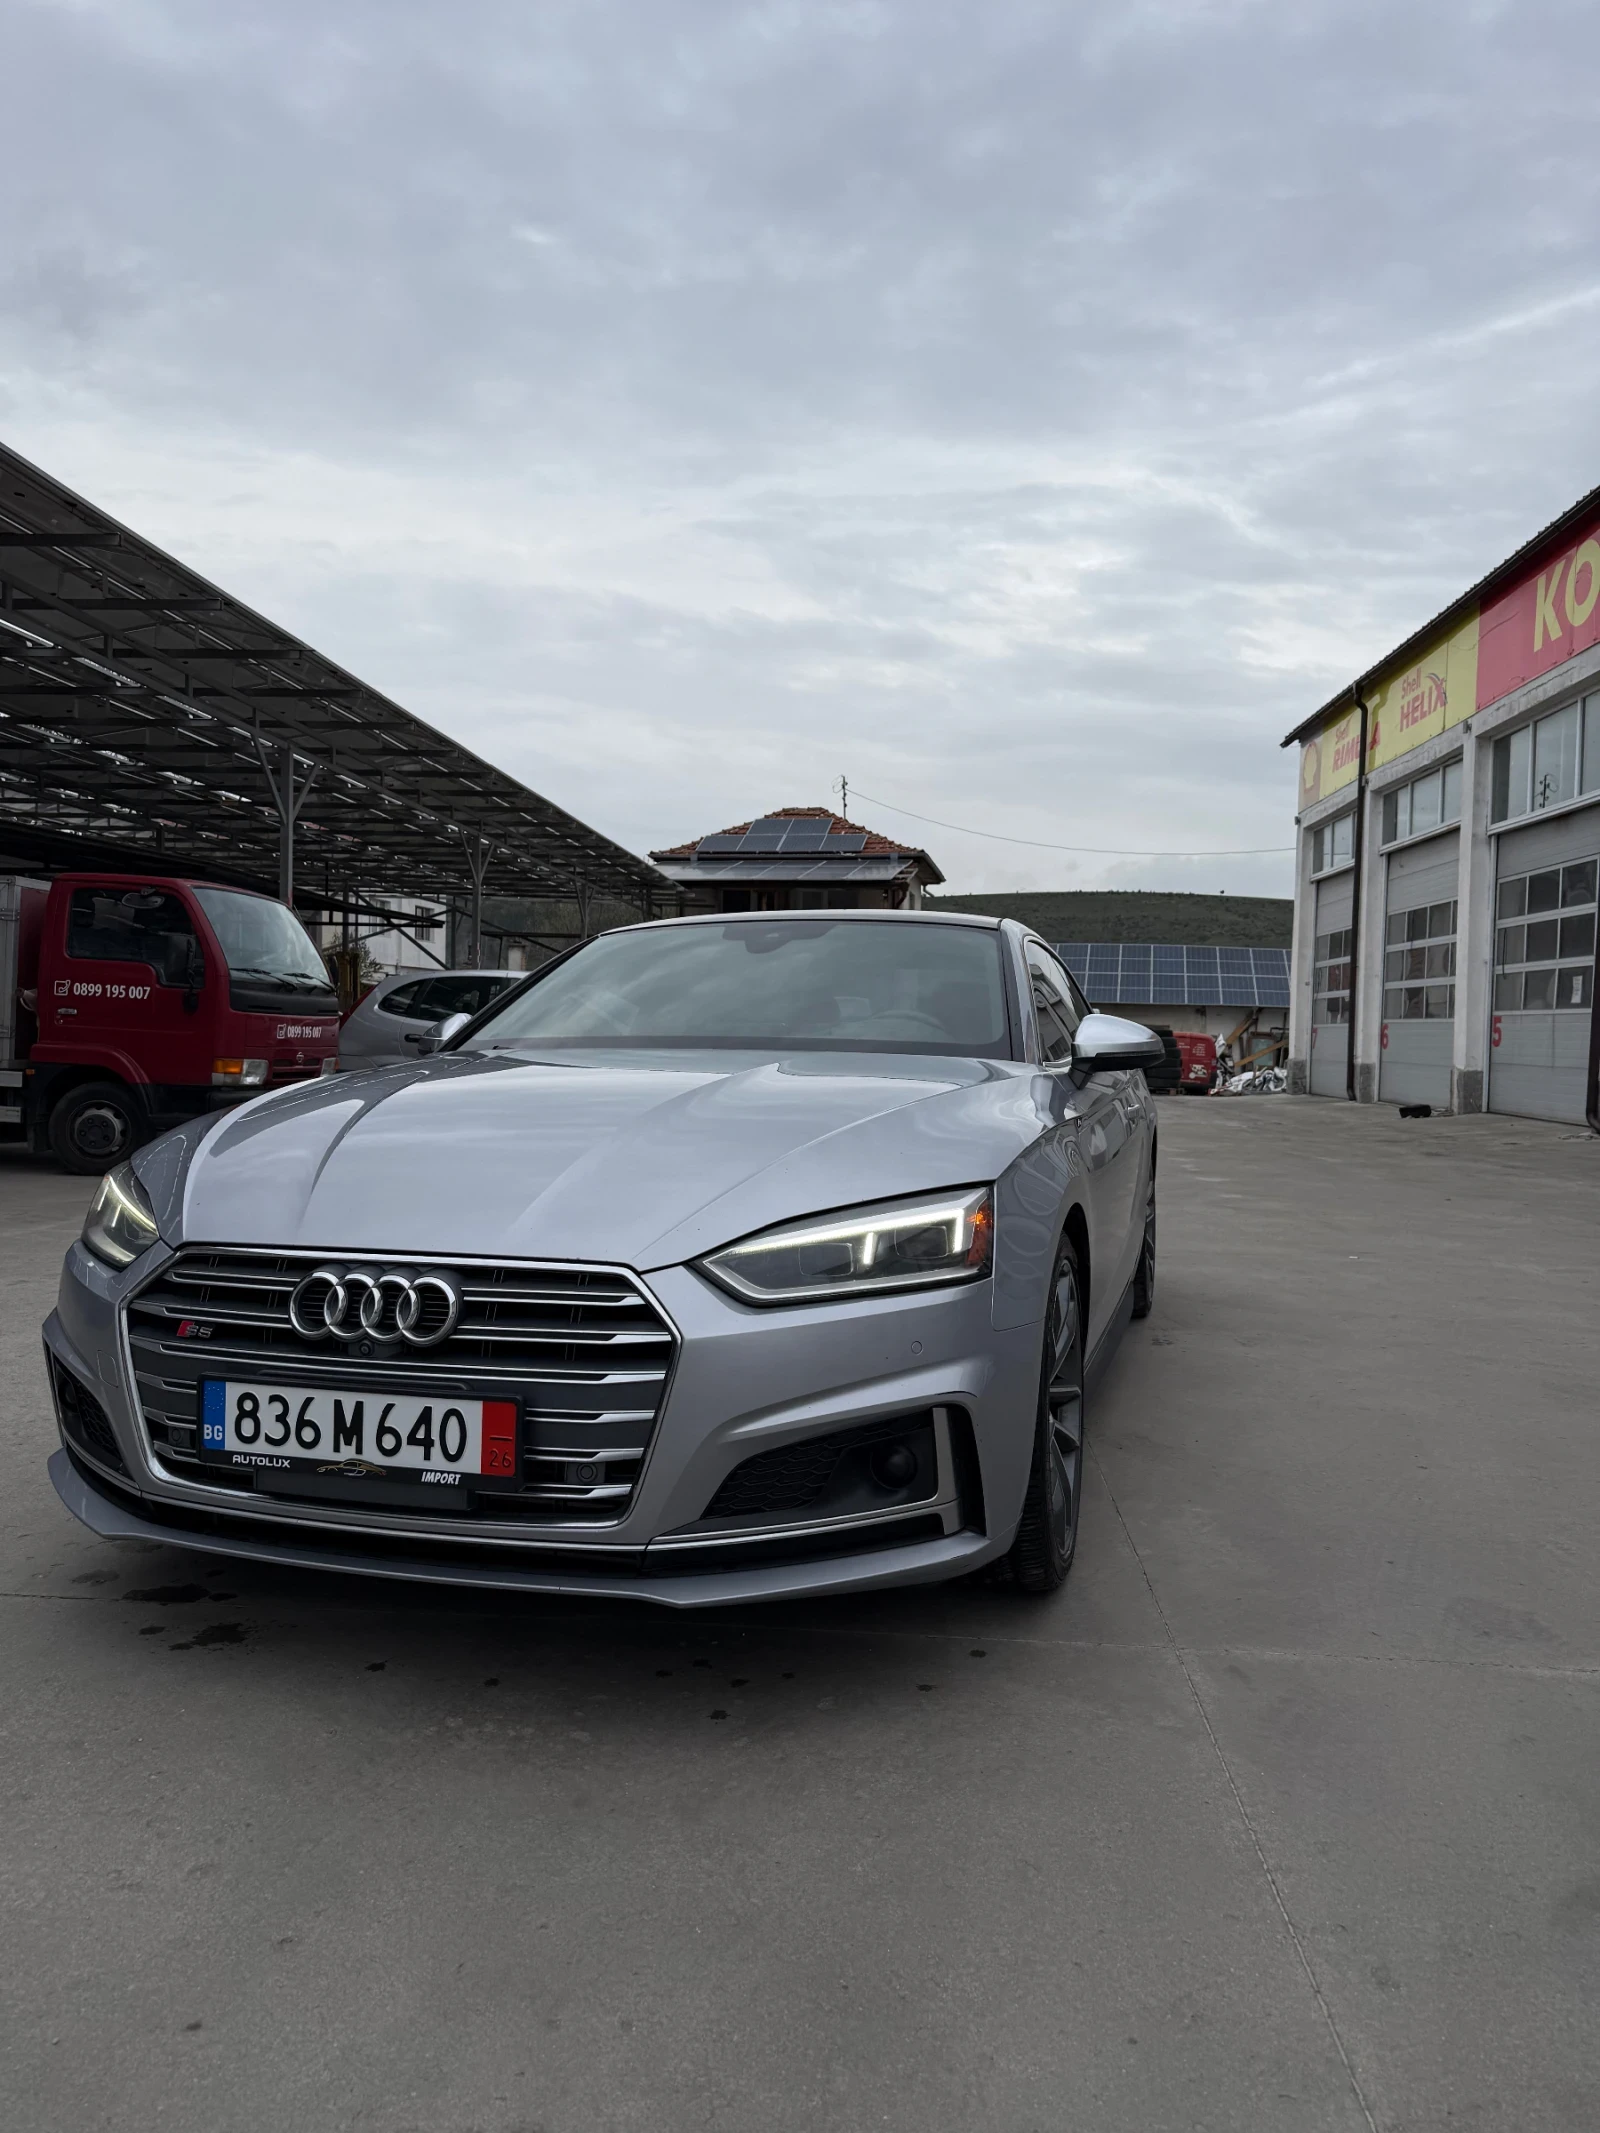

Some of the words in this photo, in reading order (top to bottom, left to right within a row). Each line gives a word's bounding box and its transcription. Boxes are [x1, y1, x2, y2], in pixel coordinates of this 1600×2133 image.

[1534, 539, 1600, 652] KO
[1401, 667, 1421, 699] Shell
[1400, 675, 1448, 732] HELIX
[1332, 721, 1380, 773] RIMA
[73, 983, 102, 996] 0899
[105, 984, 126, 998] 195
[128, 986, 151, 999] 007
[287, 1025, 301, 1038] 0899
[1381, 1023, 1389, 1050] 6
[1492, 1015, 1502, 1047] 5
[183, 1322, 214, 1339] S5
[203, 1424, 223, 1441] BG
[234, 1391, 321, 1450] 836
[333, 1399, 364, 1455] M
[376, 1403, 467, 1462] 640
[232, 1454, 291, 1468] AUTOLUX
[489, 1449, 512, 1469] 26
[421, 1471, 461, 1485] IMPORT
